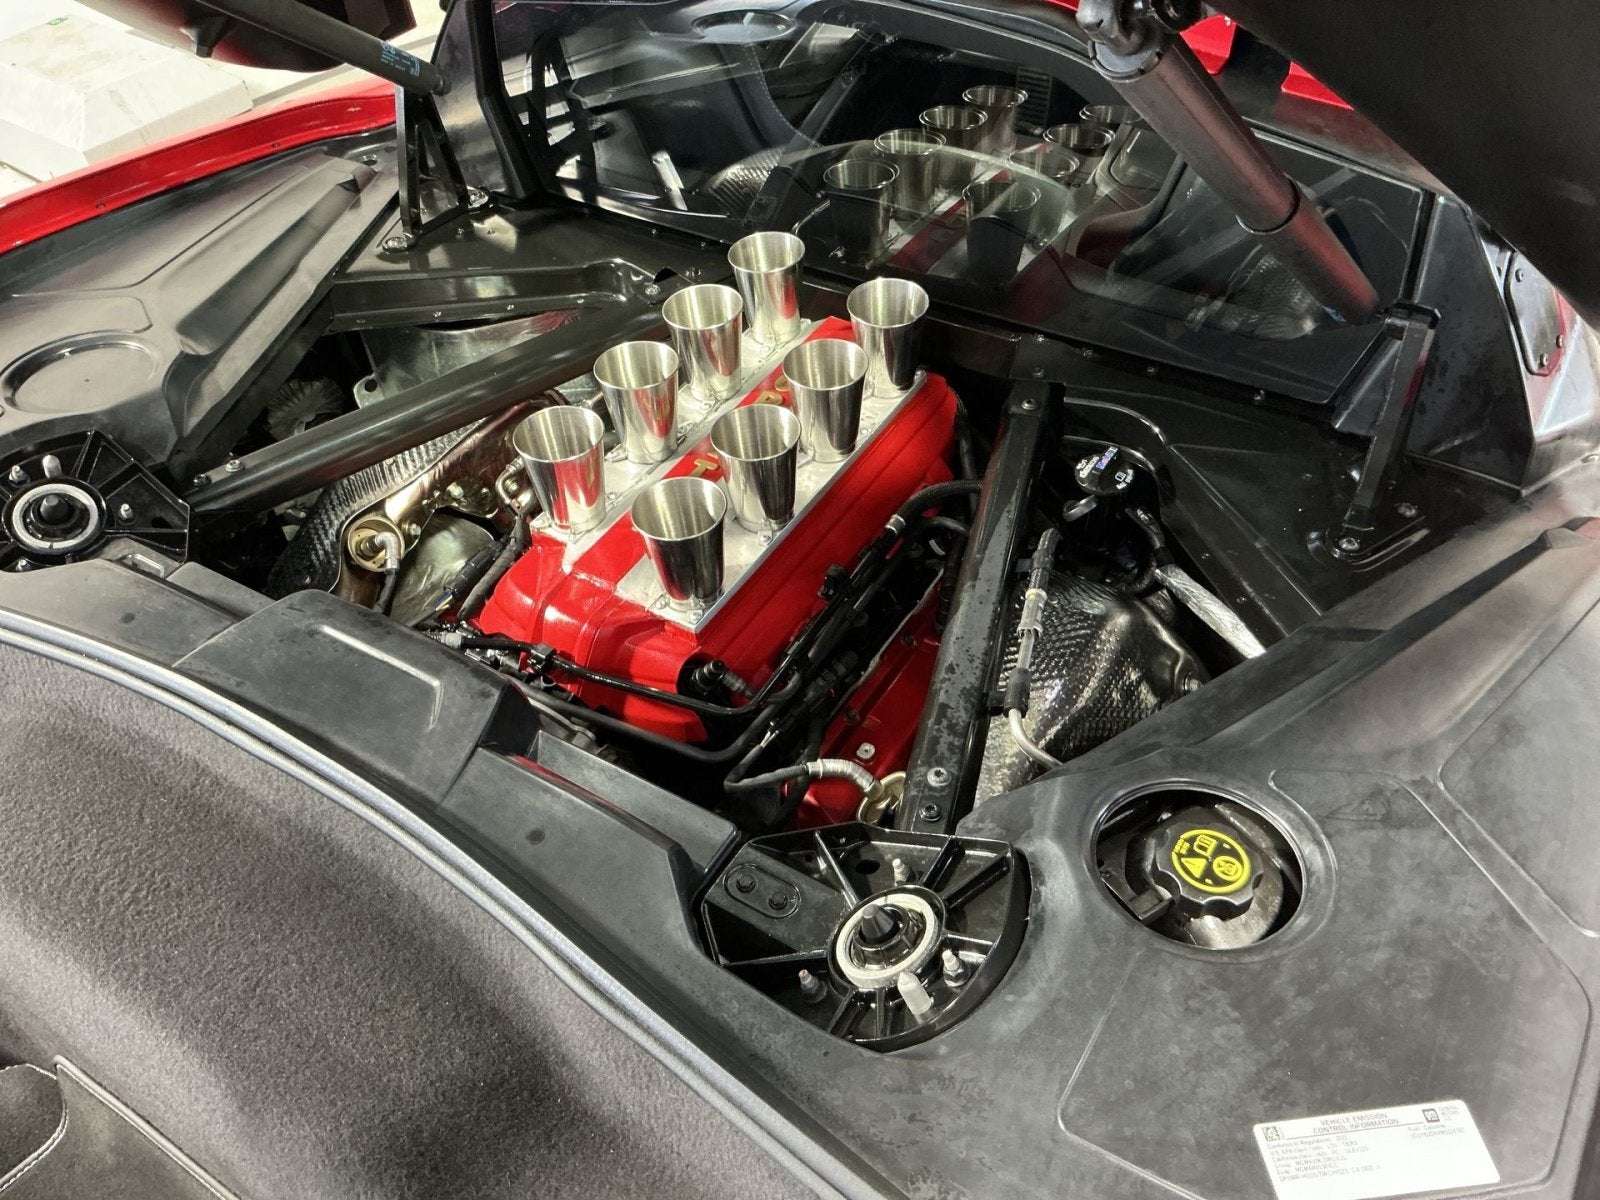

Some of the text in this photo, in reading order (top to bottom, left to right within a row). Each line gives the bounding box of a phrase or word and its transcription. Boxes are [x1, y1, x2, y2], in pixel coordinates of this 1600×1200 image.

[1313, 1118, 1400, 1135] CONTROL INFORMATION
[1319, 1112, 1388, 1126] VEHICLE EMISSION
